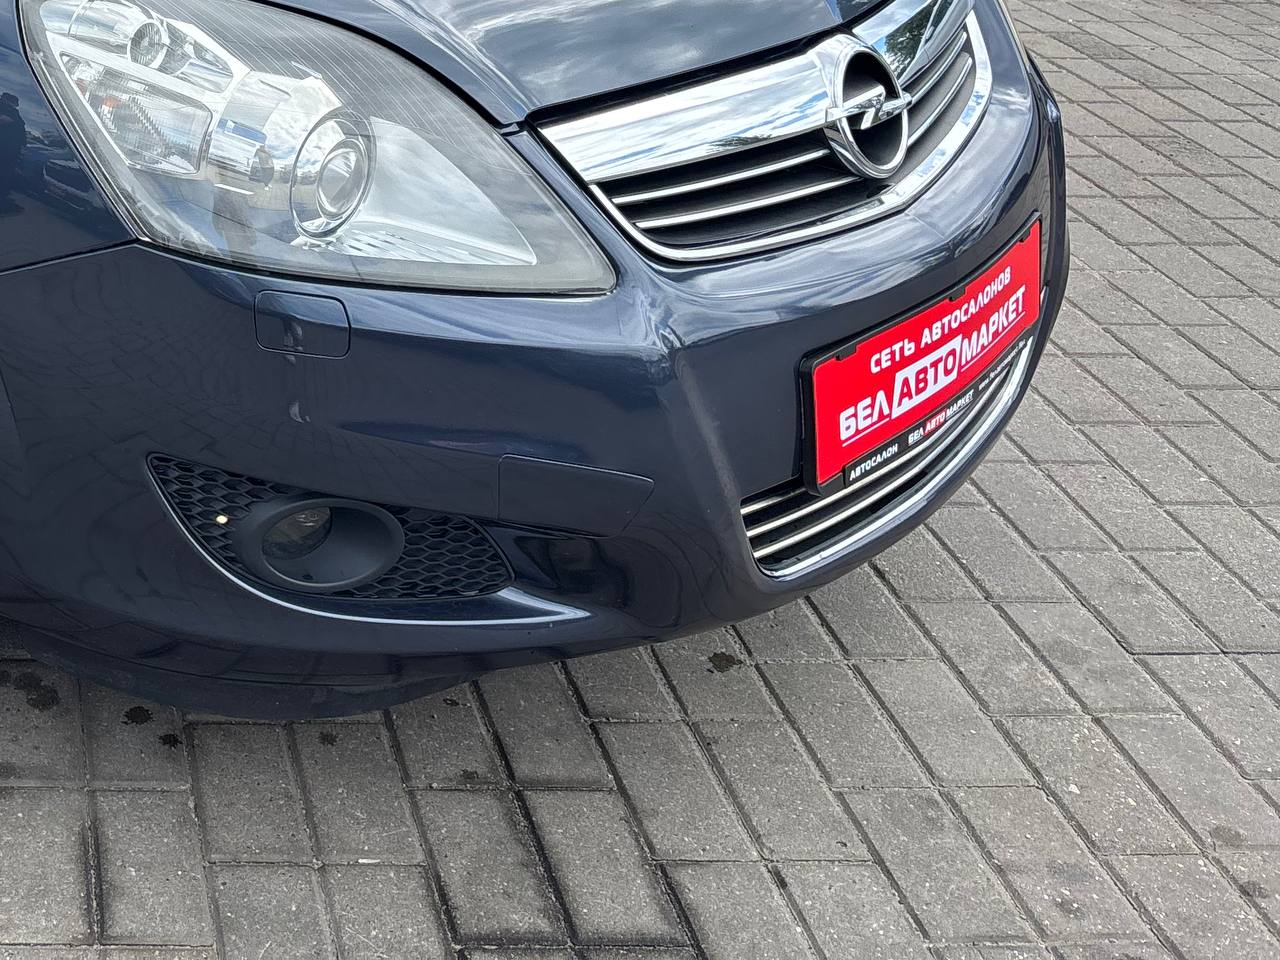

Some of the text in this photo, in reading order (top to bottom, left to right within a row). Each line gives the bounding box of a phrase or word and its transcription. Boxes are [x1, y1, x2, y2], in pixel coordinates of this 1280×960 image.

[839, 390, 890, 441] БЕЛ
[896, 352, 958, 410] АВТО
[961, 285, 1026, 366] МАРКЕТ
[870, 338, 916, 374] СЕТЬ
[920, 266, 1012, 348] АВТОСАЛОНОВ
[849, 443, 899, 481] АВТОСАЛОН
